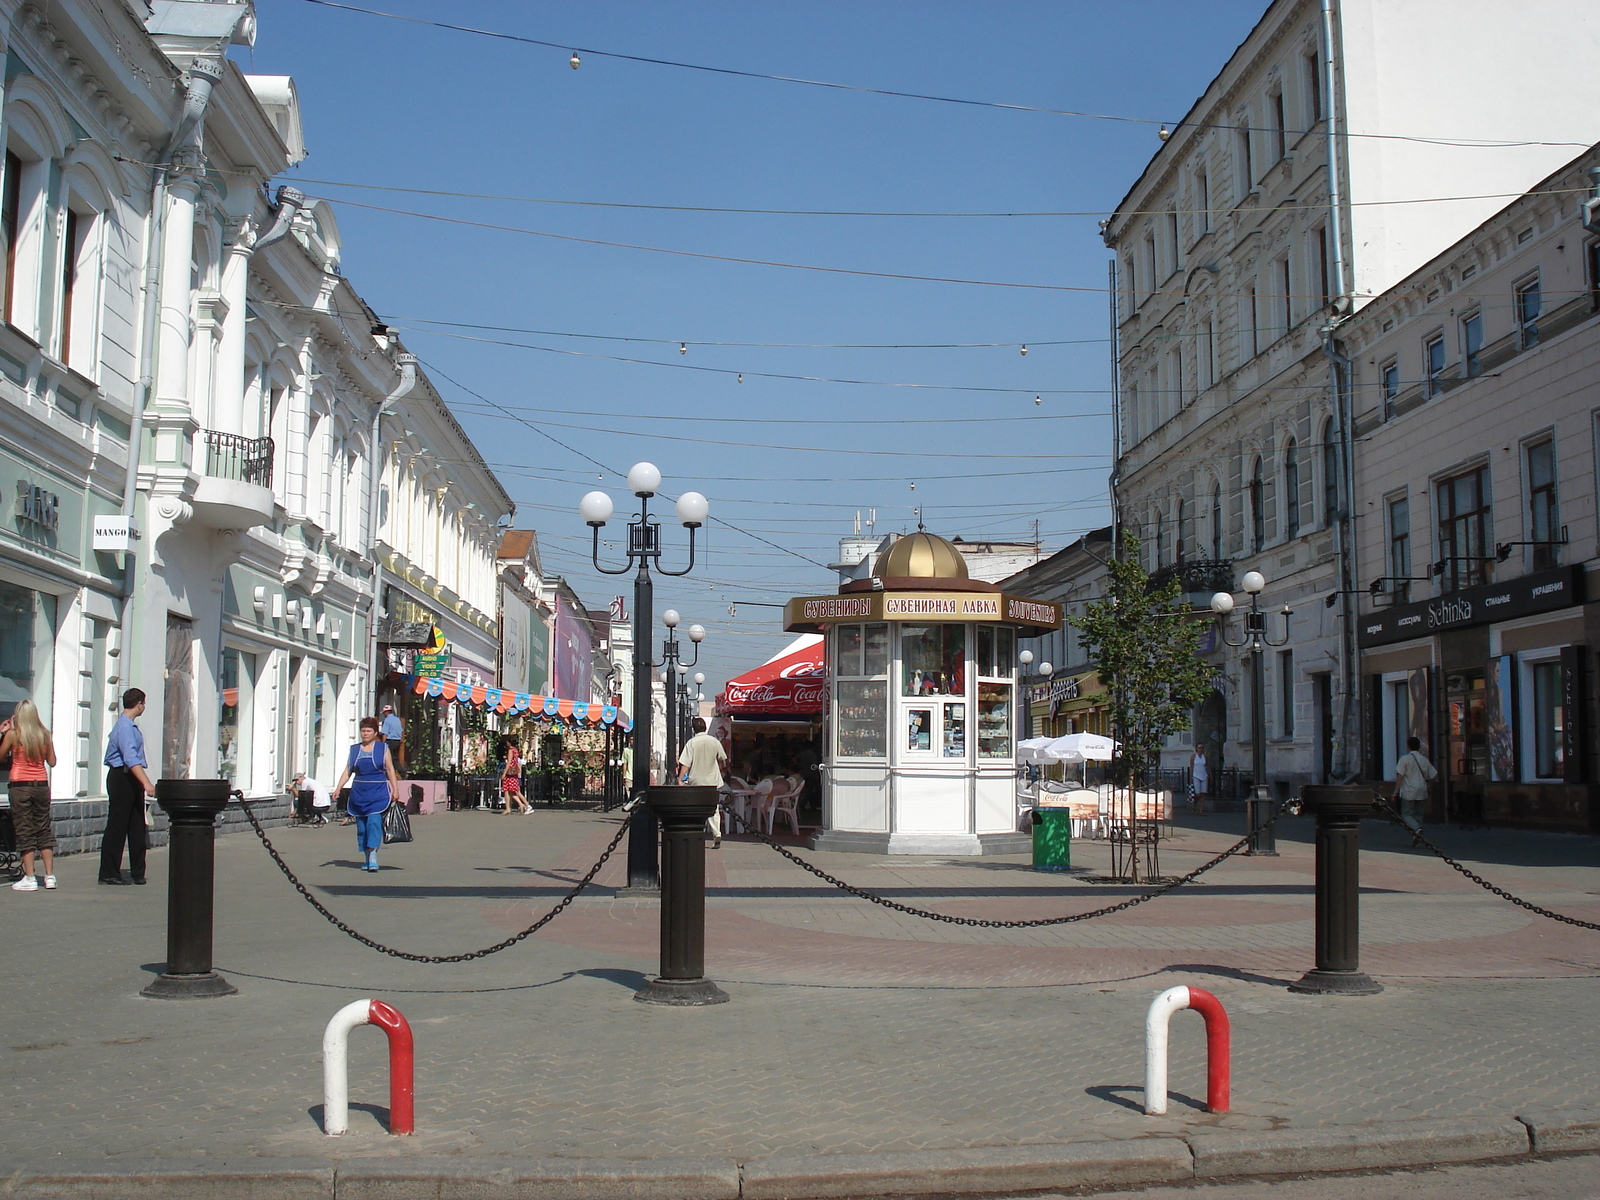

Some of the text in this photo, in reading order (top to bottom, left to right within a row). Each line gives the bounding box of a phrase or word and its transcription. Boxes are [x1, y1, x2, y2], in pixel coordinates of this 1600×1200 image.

[95, 528, 127, 536] MANGO
[804, 598, 871, 618] СУВЕНИРЫ
[886, 599, 998, 614] СУВЕНИРНАЯ ЛАВКА
[1008, 600, 1055, 623] SOUVENIRS
[1428, 598, 1472, 627] Schinka
[1532, 581, 1563, 599] УКРАШЕНИЯ
